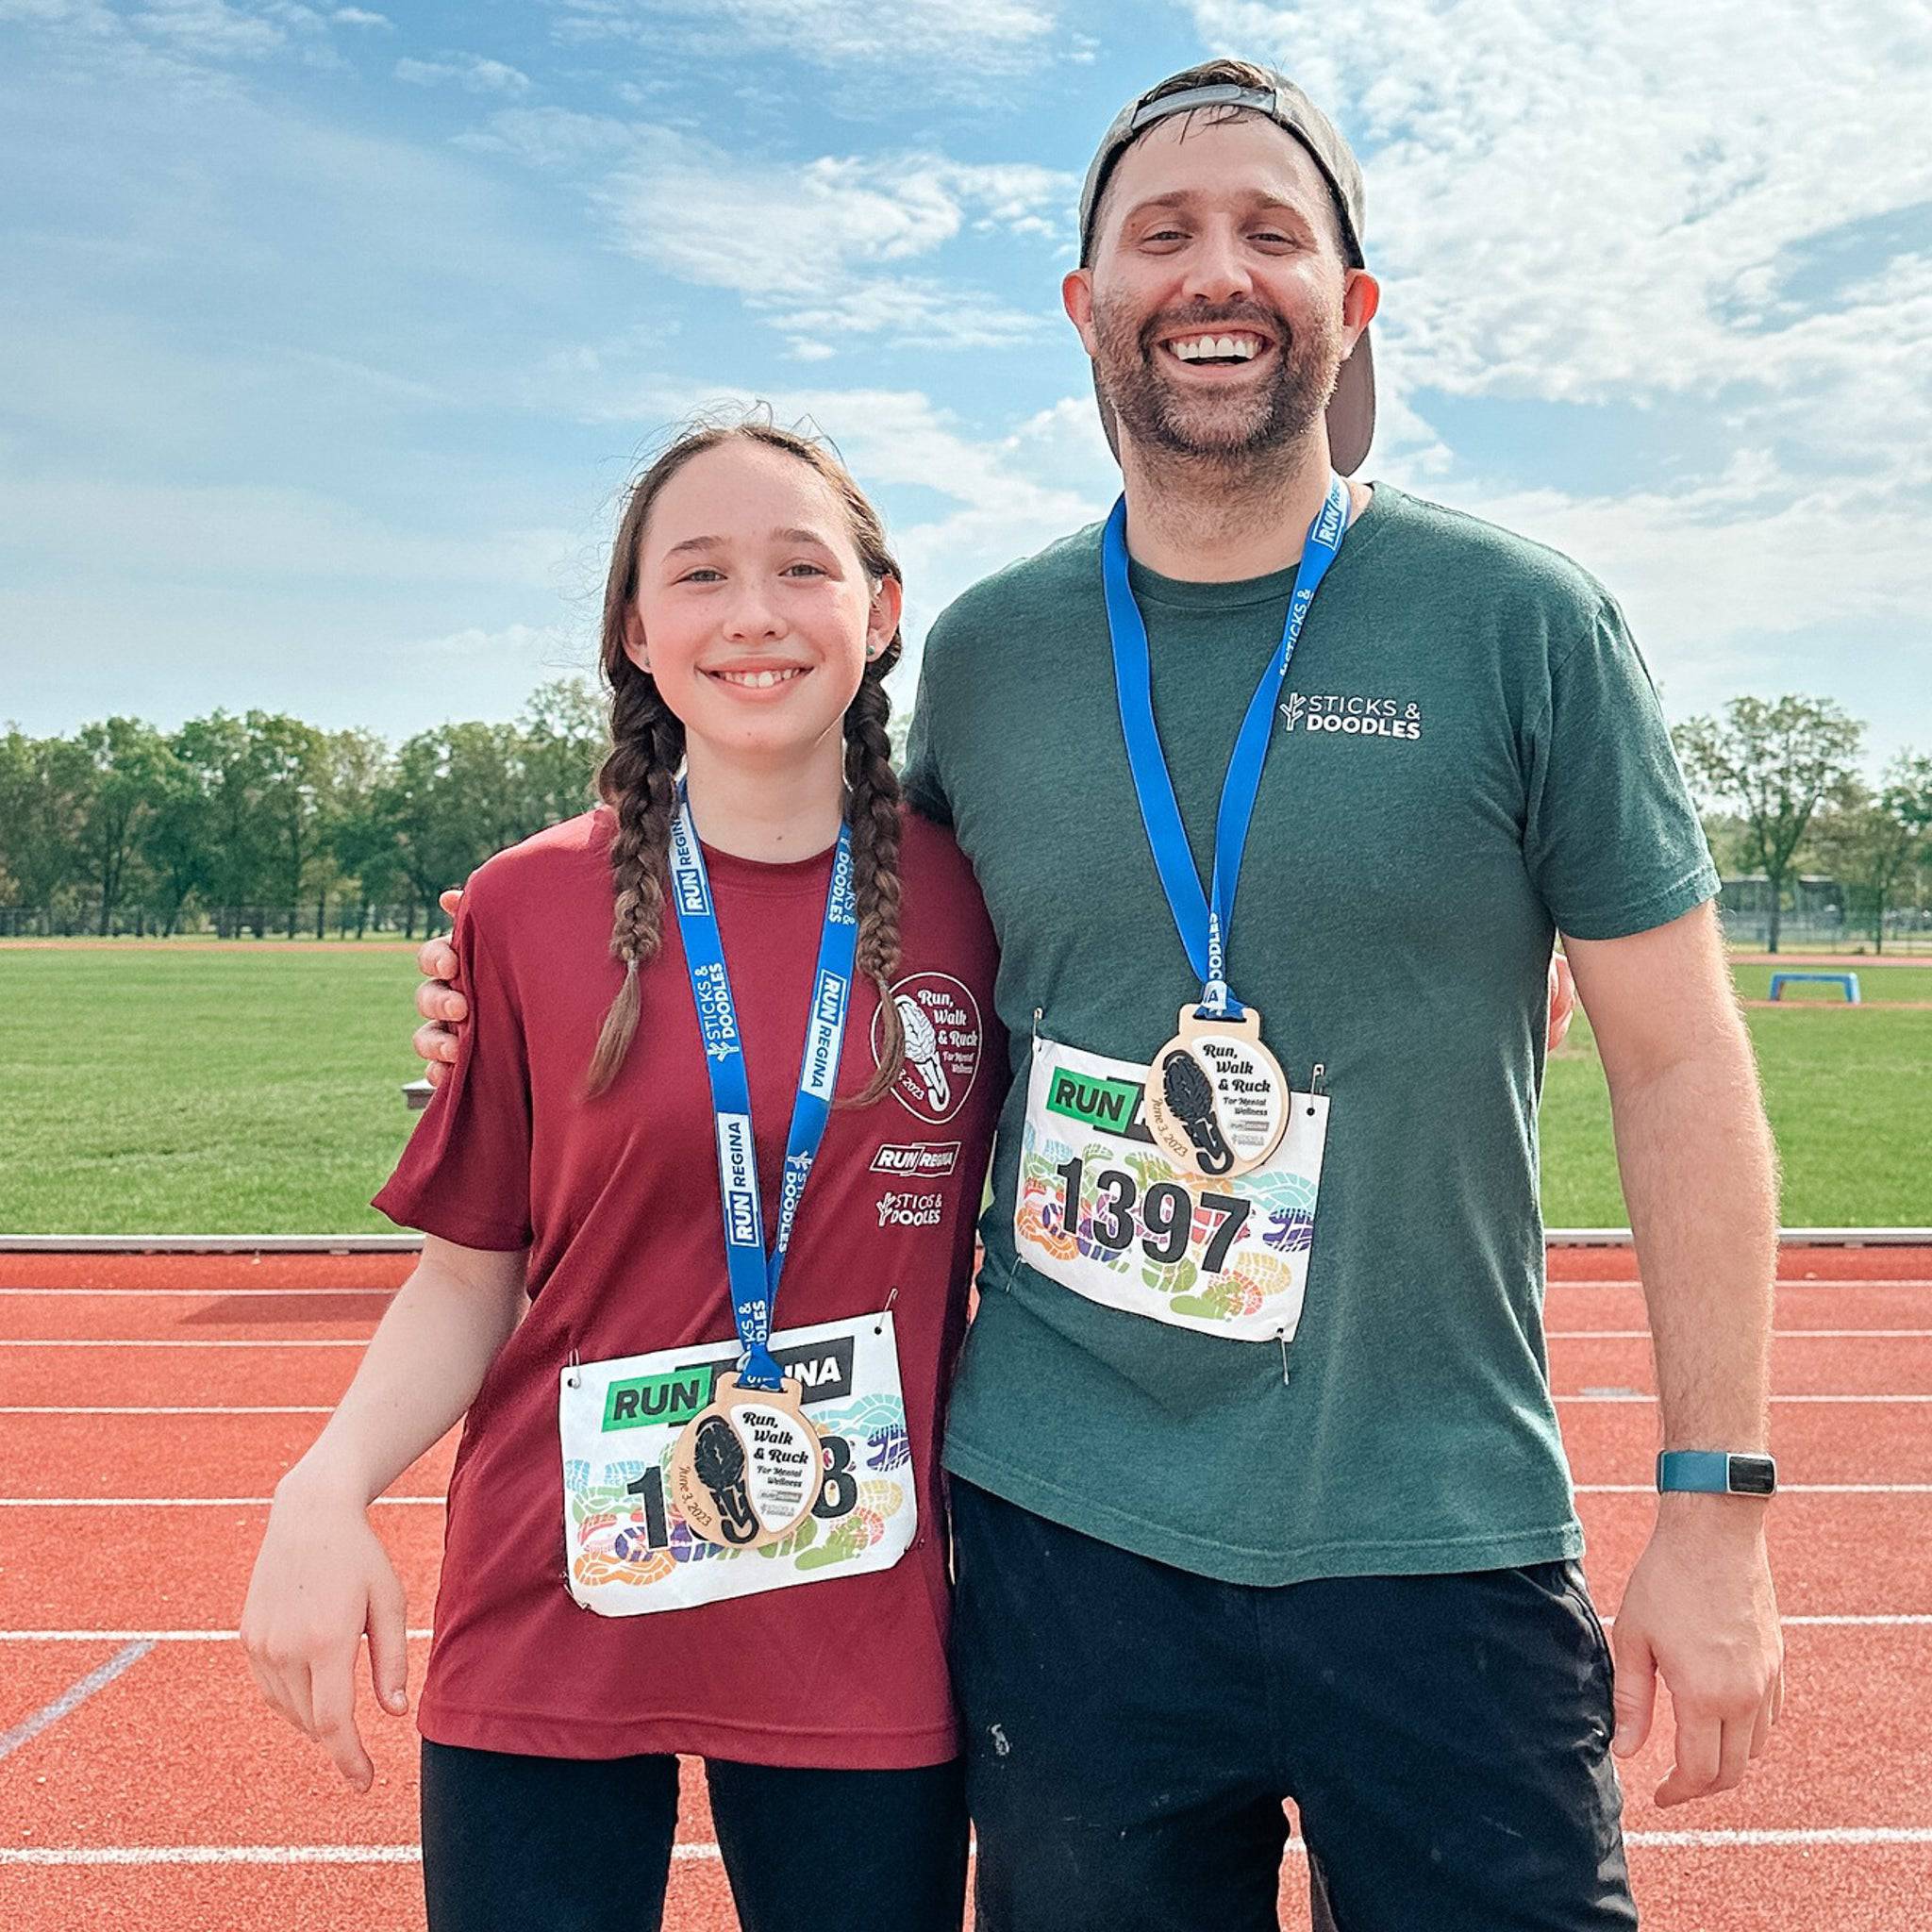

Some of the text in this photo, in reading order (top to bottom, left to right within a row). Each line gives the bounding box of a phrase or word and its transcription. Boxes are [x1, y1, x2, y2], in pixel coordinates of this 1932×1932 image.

[1318, 504, 1340, 542] RUN
[1308, 695, 1421, 720] STICKS &
[1307, 714, 1421, 740] DOODLES
[685, 872, 705, 910] RUN
[828, 851, 850, 924] DOODLES
[694, 965, 722, 1041] STICKS &
[709, 961, 736, 1039] DOODLES
[918, 990, 955, 1008] Run,
[933, 1009, 967, 1025] Walk
[811, 978, 842, 1088] RUN REGINA
[938, 1029, 978, 1047] & Ruck
[1203, 1043, 1238, 1058] Run,
[1216, 1061, 1254, 1074] Walk
[1218, 1078, 1271, 1093] & Ruck
[1055, 1078, 1126, 1122] RUN
[1151, 1098, 1164, 1124] June
[1163, 1133, 1189, 1158] 2023
[877, 1149, 919, 1168] RUN
[729, 1121, 755, 1242] RUN REGINA
[1057, 1157, 1251, 1274] 1397
[739, 1302, 753, 1315] &
[753, 1299, 768, 1343] DLES
[614, 1380, 700, 1421] RUN
[742, 1411, 778, 1428] Run,
[755, 1429, 793, 1445] Walk
[753, 1448, 808, 1465] & Ruck
[627, 1435, 858, 1549] 18
[688, 1502, 713, 1526] 2023
